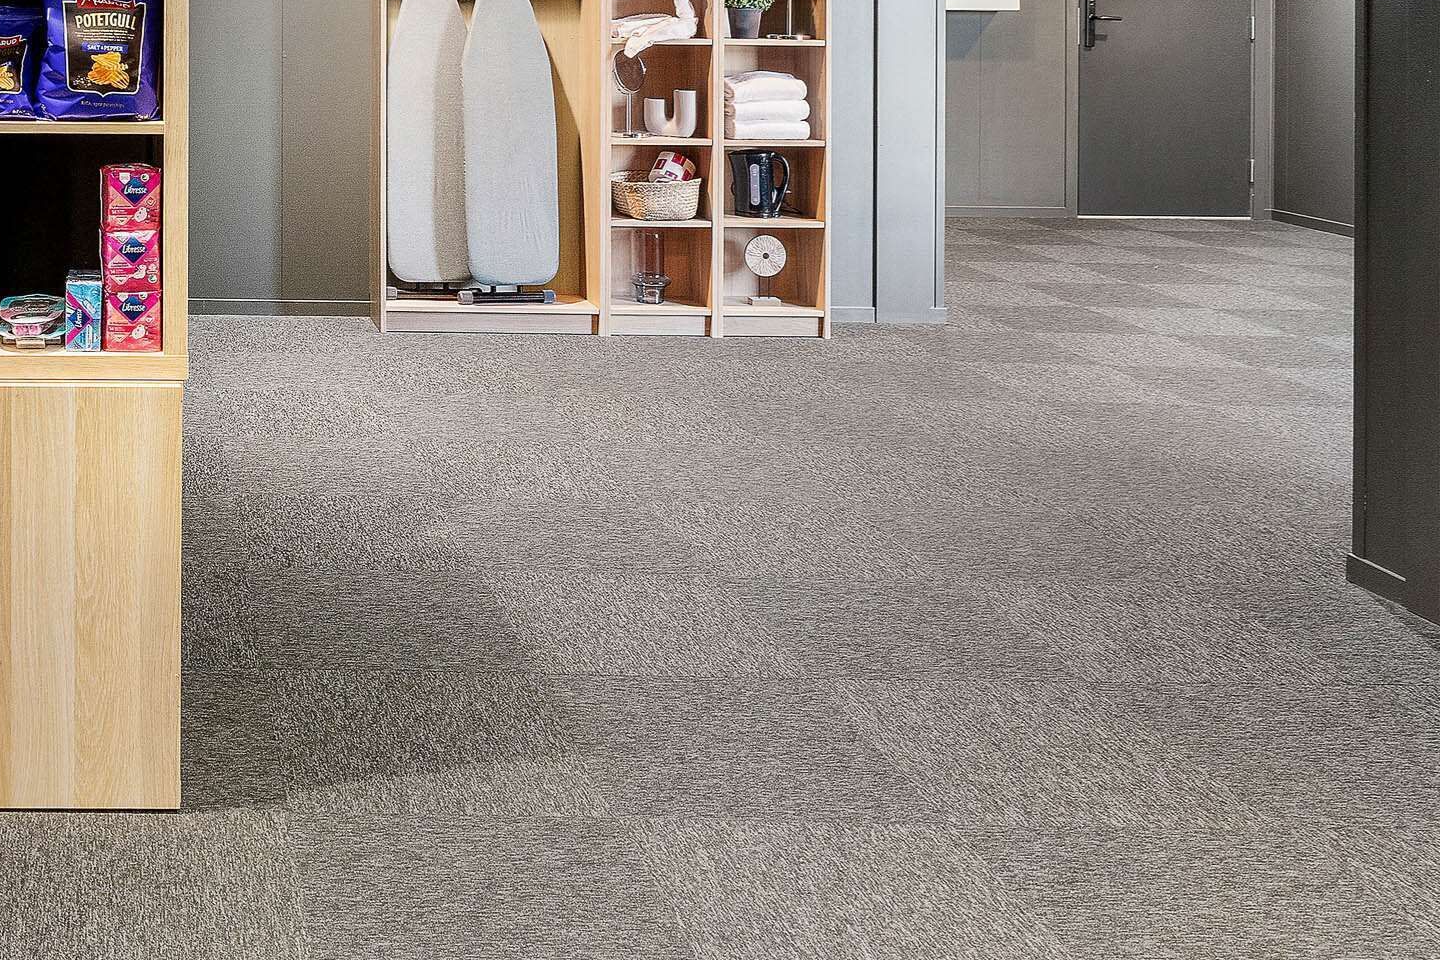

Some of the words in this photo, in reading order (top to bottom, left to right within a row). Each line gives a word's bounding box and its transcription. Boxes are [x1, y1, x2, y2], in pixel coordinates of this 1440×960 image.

[74, 12, 136, 31] POTETGULL
[124, 185, 148, 195] Libresse
[122, 244, 146, 254] Libresse
[121, 302, 147, 312] Libresse
